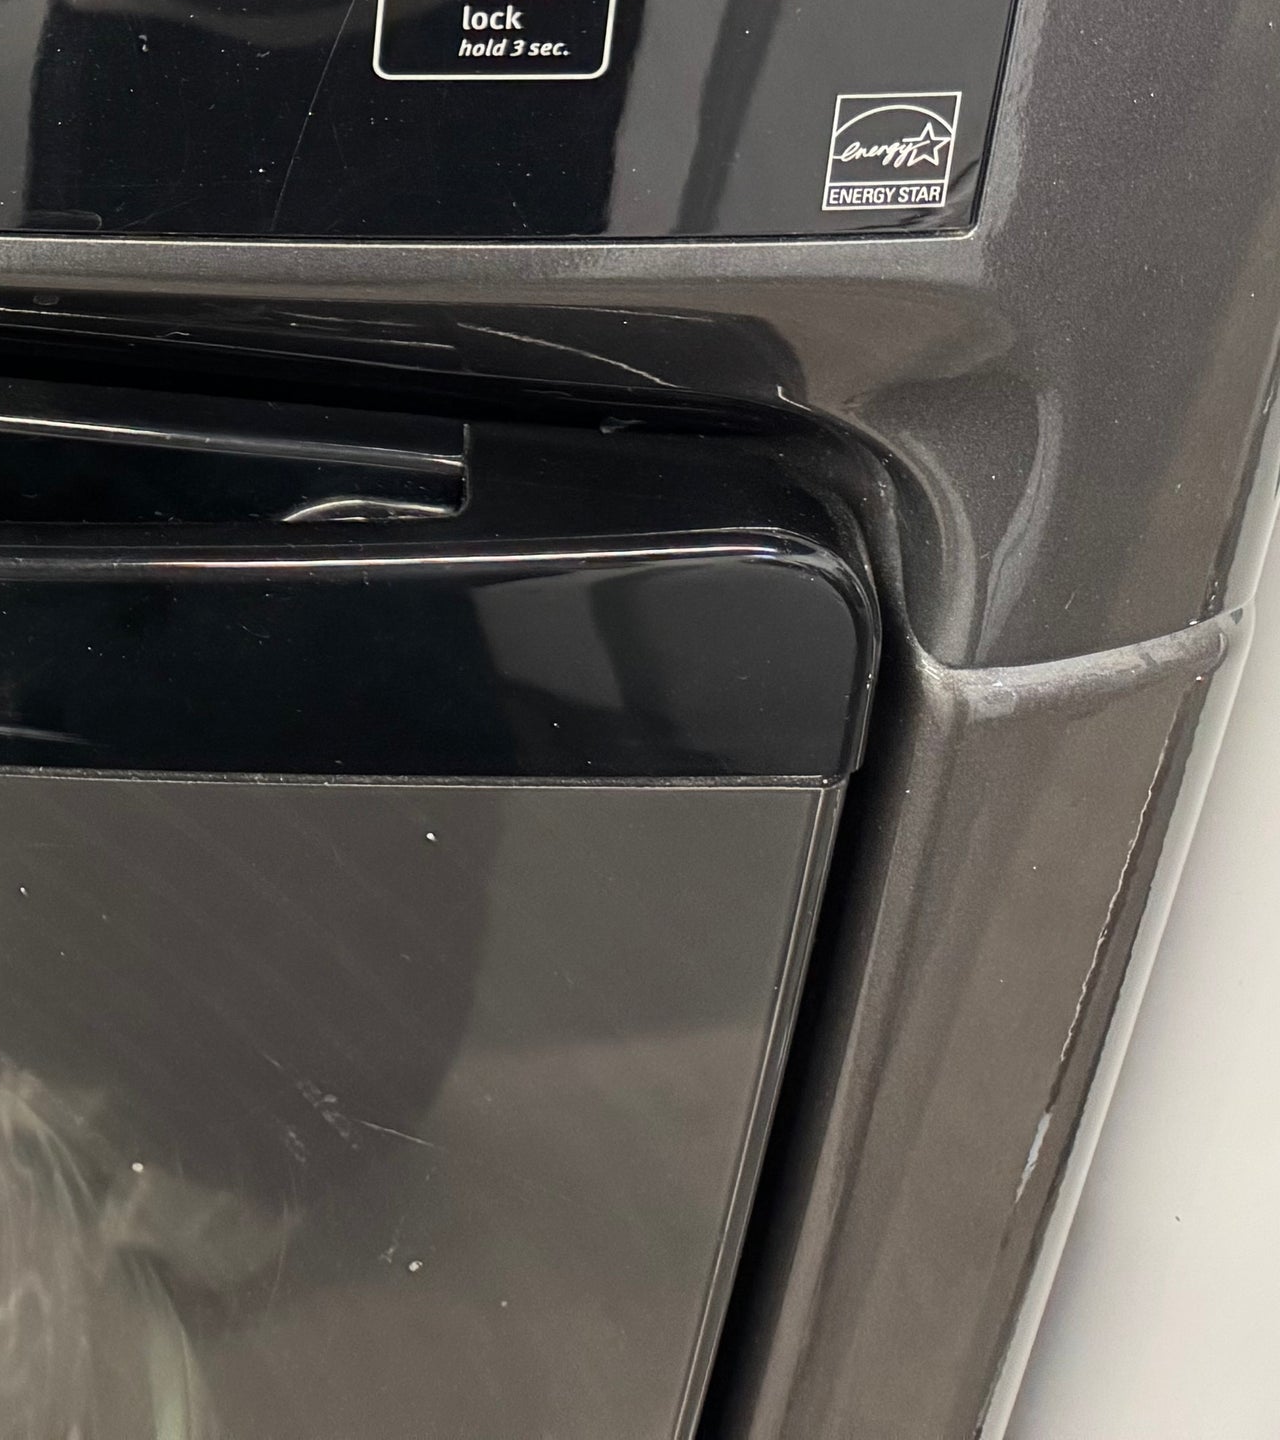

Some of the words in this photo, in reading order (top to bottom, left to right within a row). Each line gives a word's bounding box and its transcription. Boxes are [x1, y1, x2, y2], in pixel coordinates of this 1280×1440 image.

[462, 4, 522, 30] lock
[458, 38, 508, 57] hold
[509, 39, 526, 57] 3
[527, 42, 569, 56] sec.
[829, 187, 896, 204] ENERGY
[897, 186, 941, 203] STAR
